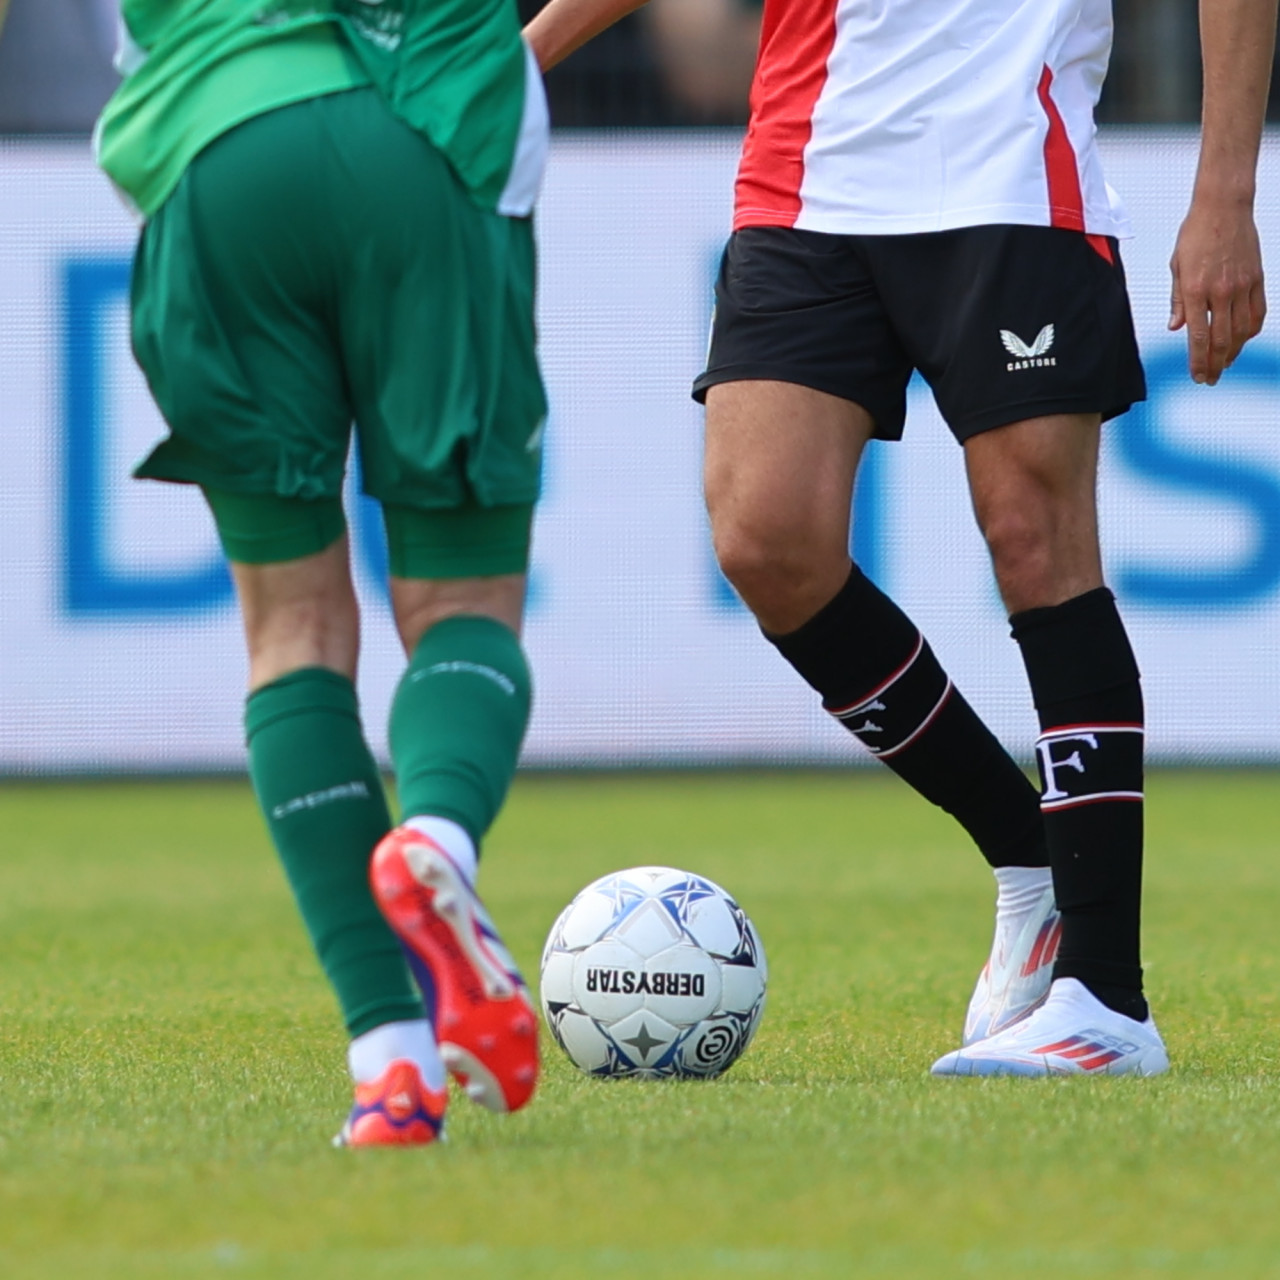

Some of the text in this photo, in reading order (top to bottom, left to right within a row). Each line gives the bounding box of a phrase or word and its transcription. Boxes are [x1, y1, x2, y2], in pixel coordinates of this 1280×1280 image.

[1006, 356, 1057, 372] CASTORE
[1036, 733, 1100, 802] F
[586, 968, 705, 997] DERBYSTAR
